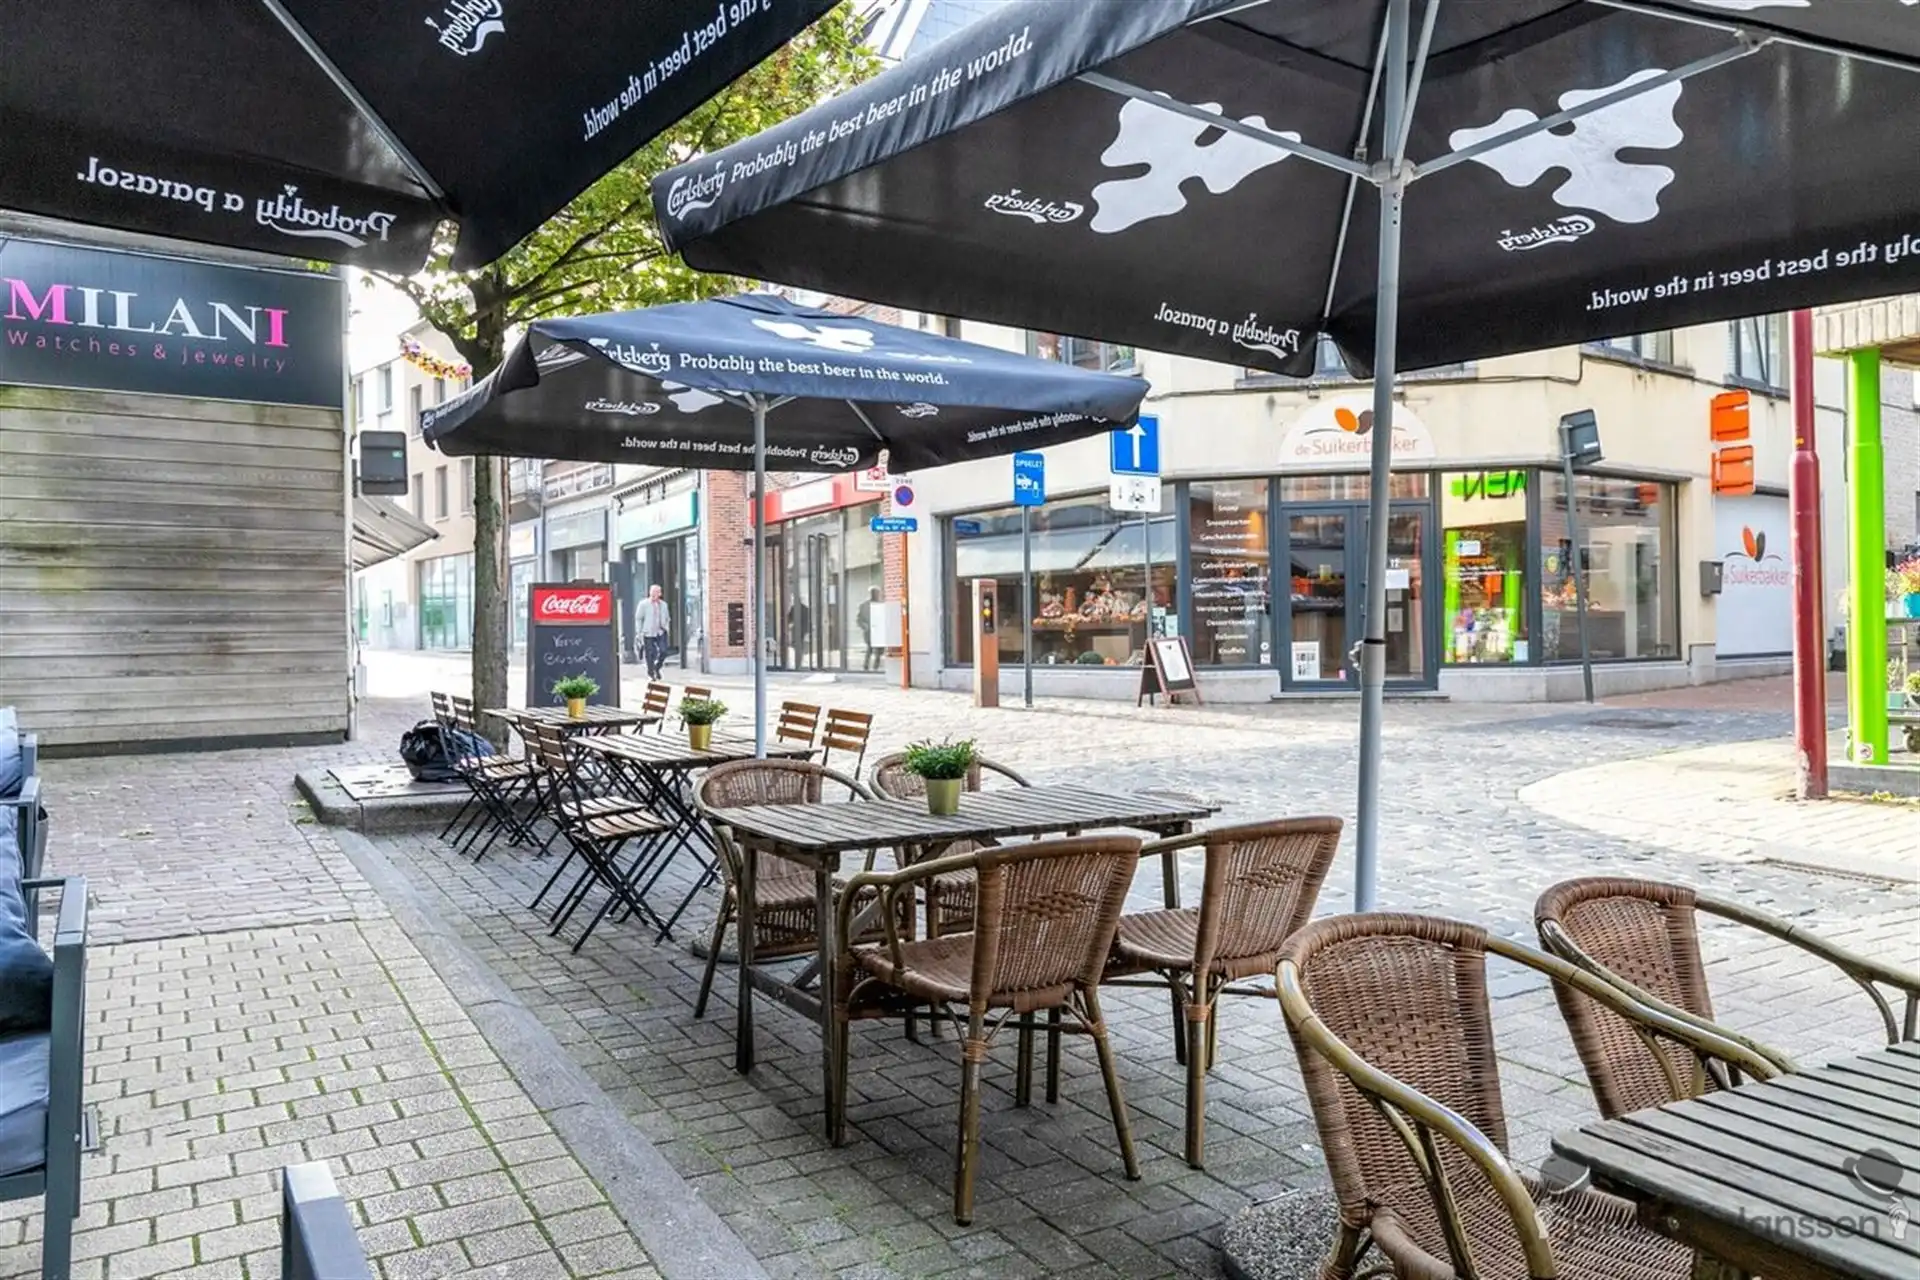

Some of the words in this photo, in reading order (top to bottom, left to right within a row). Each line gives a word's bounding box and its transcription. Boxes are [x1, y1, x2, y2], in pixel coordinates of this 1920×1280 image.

[667, 162, 728, 221] Carlsberg
[731, 139, 798, 184] Probably
[800, 131, 825, 155] the
[828, 114, 864, 142] best
[865, 102, 907, 126] beer
[908, 83, 928, 107] in
[931, 68, 962, 96] the
[967, 26, 1033, 80] world.
[4, 278, 288, 347] MILANI
[7, 329, 138, 357] Watches
[152, 343, 167, 360] &
[588, 338, 671, 374] rlsberg
[680, 352, 755, 375] Probably
[759, 357, 784, 372] the
[787, 359, 821, 375] best
[822, 362, 857, 378] beer
[860, 366, 875, 380] in
[877, 368, 901, 381] the
[902, 371, 949, 385] world.
[1295, 443, 1310, 456] de
[1311, 437, 1419, 456] Suikerbker
